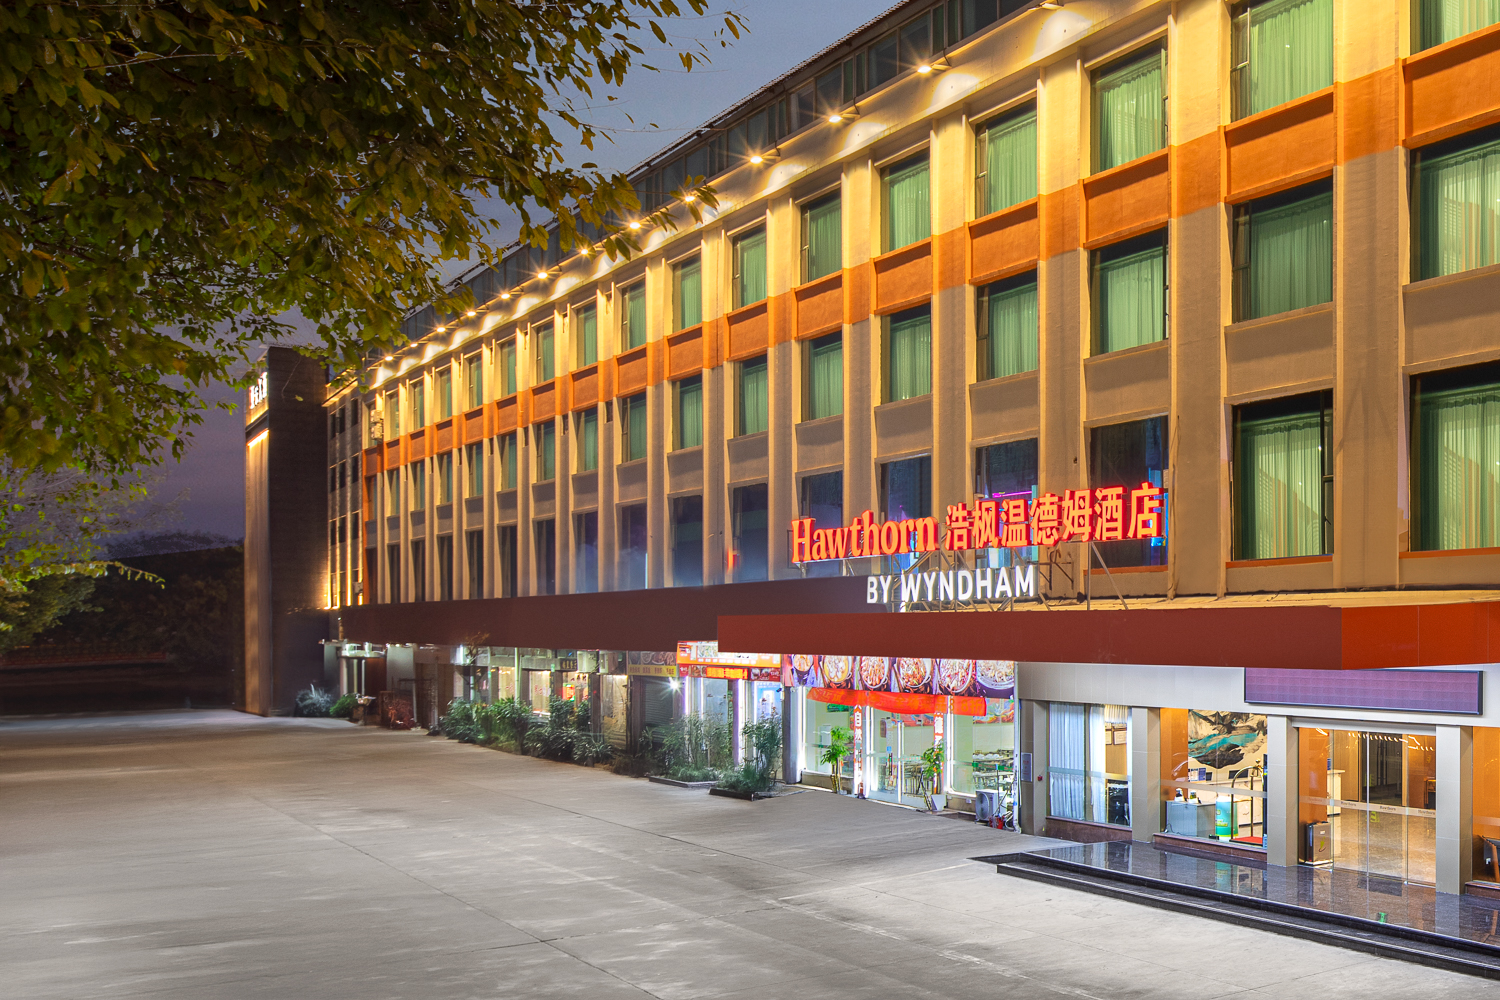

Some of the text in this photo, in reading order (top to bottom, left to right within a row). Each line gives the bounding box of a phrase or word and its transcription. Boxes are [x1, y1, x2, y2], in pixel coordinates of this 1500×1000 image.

[791, 482, 1165, 563] Hawthorn 浩枫温德姆酒店
[866, 565, 1036, 604] BY WYNDHAM
